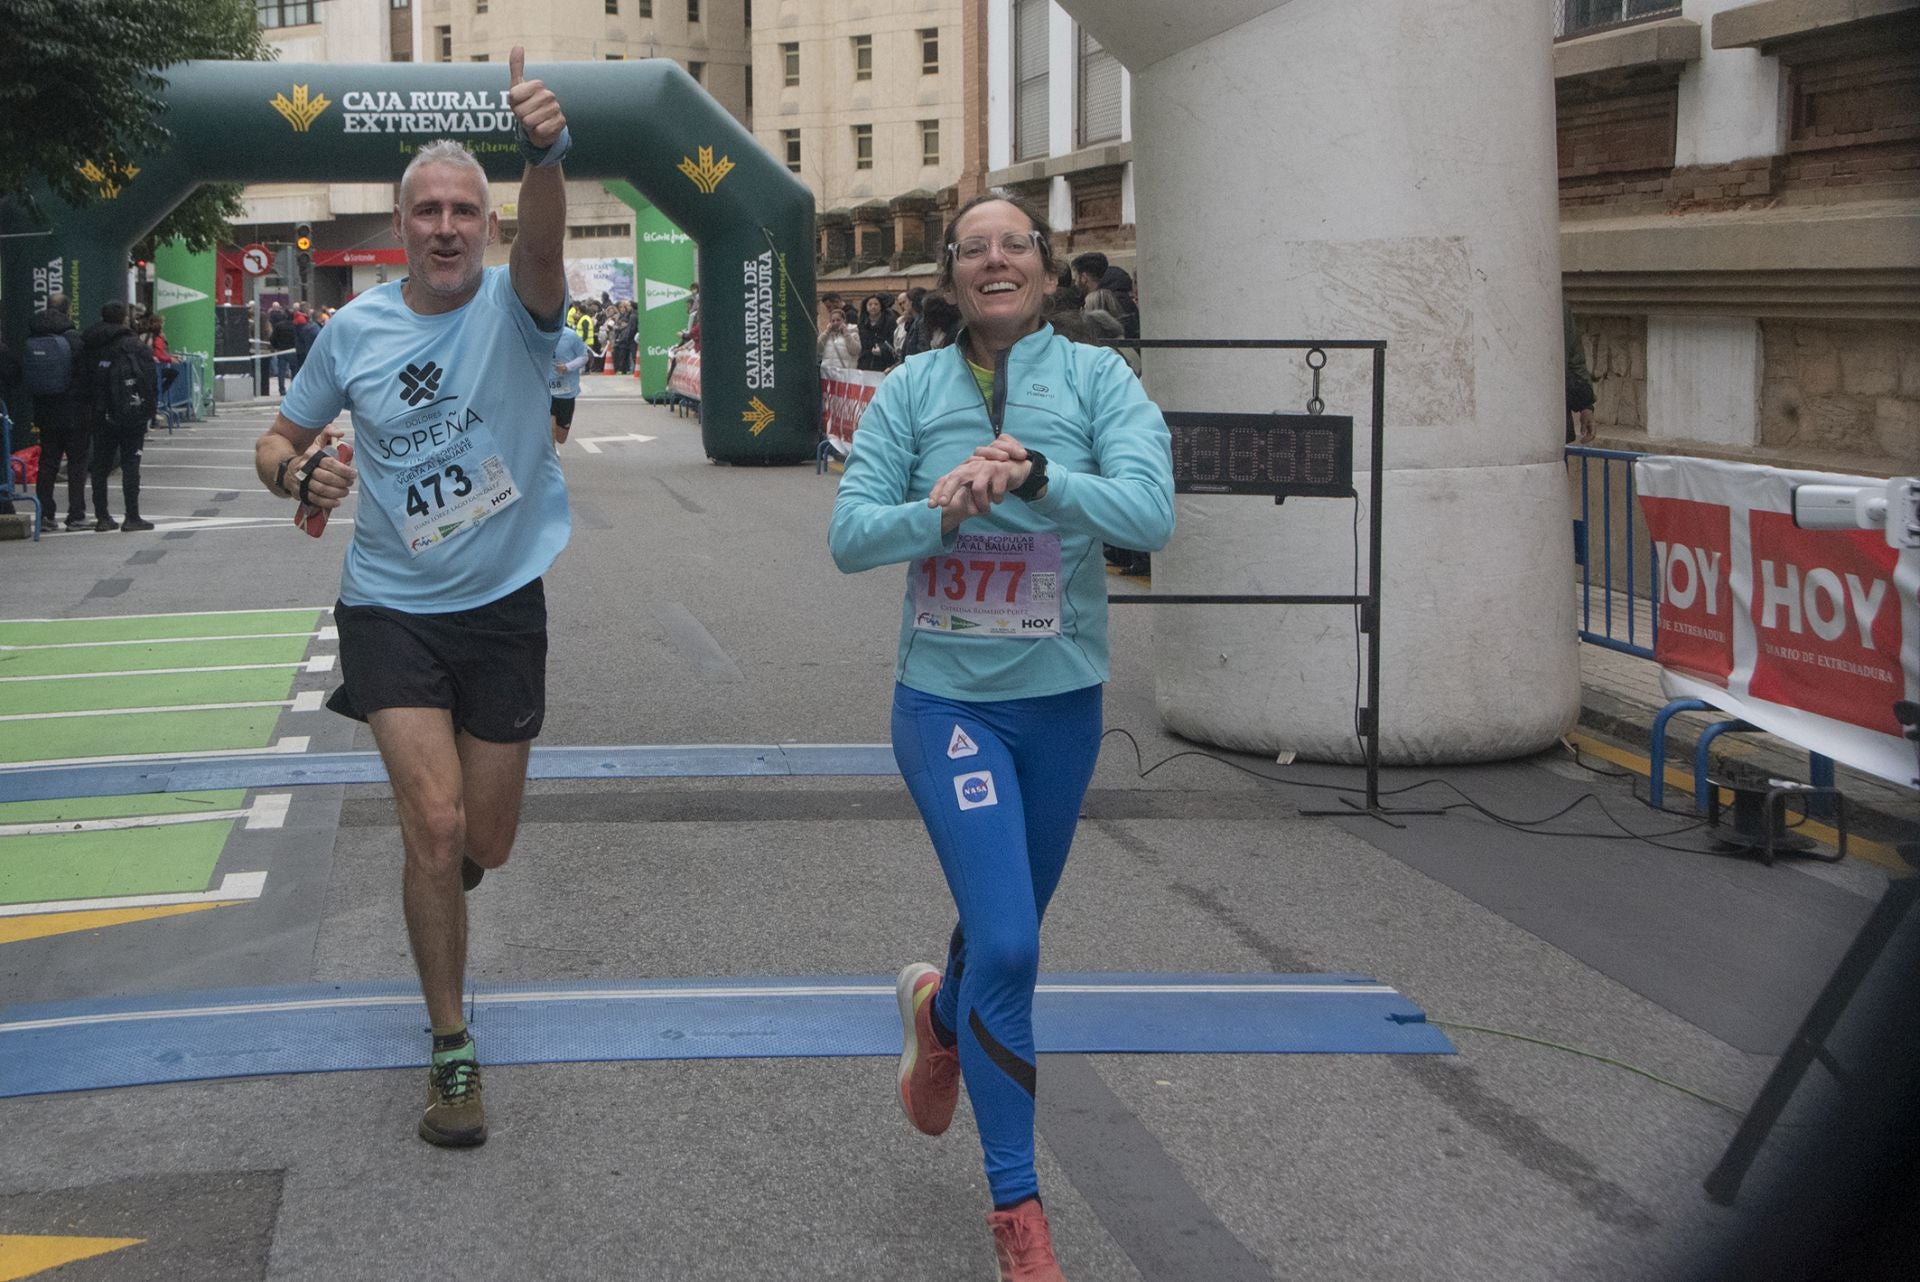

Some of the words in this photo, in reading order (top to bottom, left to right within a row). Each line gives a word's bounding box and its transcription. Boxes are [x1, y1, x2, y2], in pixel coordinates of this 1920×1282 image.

[342, 91, 406, 112] CAJA
[410, 91, 496, 110] RURAL
[343, 112, 516, 133] EXTREMADU
[33, 267, 47, 293] DE
[744, 261, 757, 285] DE
[745, 288, 759, 345] RURAL
[759, 250, 775, 388] EXTREMADURA
[746, 347, 760, 388] CAJA
[405, 410, 442, 428] DOLORES
[378, 407, 483, 459] SOPEÑA
[397, 464, 426, 485] VUELTA
[406, 464, 472, 517] 473
[491, 486, 512, 507] HOY
[970, 542, 981, 551] AL
[985, 542, 1034, 552] BALUARTE
[922, 557, 1026, 603] 1377
[1760, 559, 1886, 650] HOY
[1022, 618, 1054, 629] HOY
[1765, 643, 1801, 662] DIARIO
[1802, 651, 1816, 663] DE
[1817, 653, 1893, 682] EXTREMADURA
[965, 785, 987, 794] NASA
